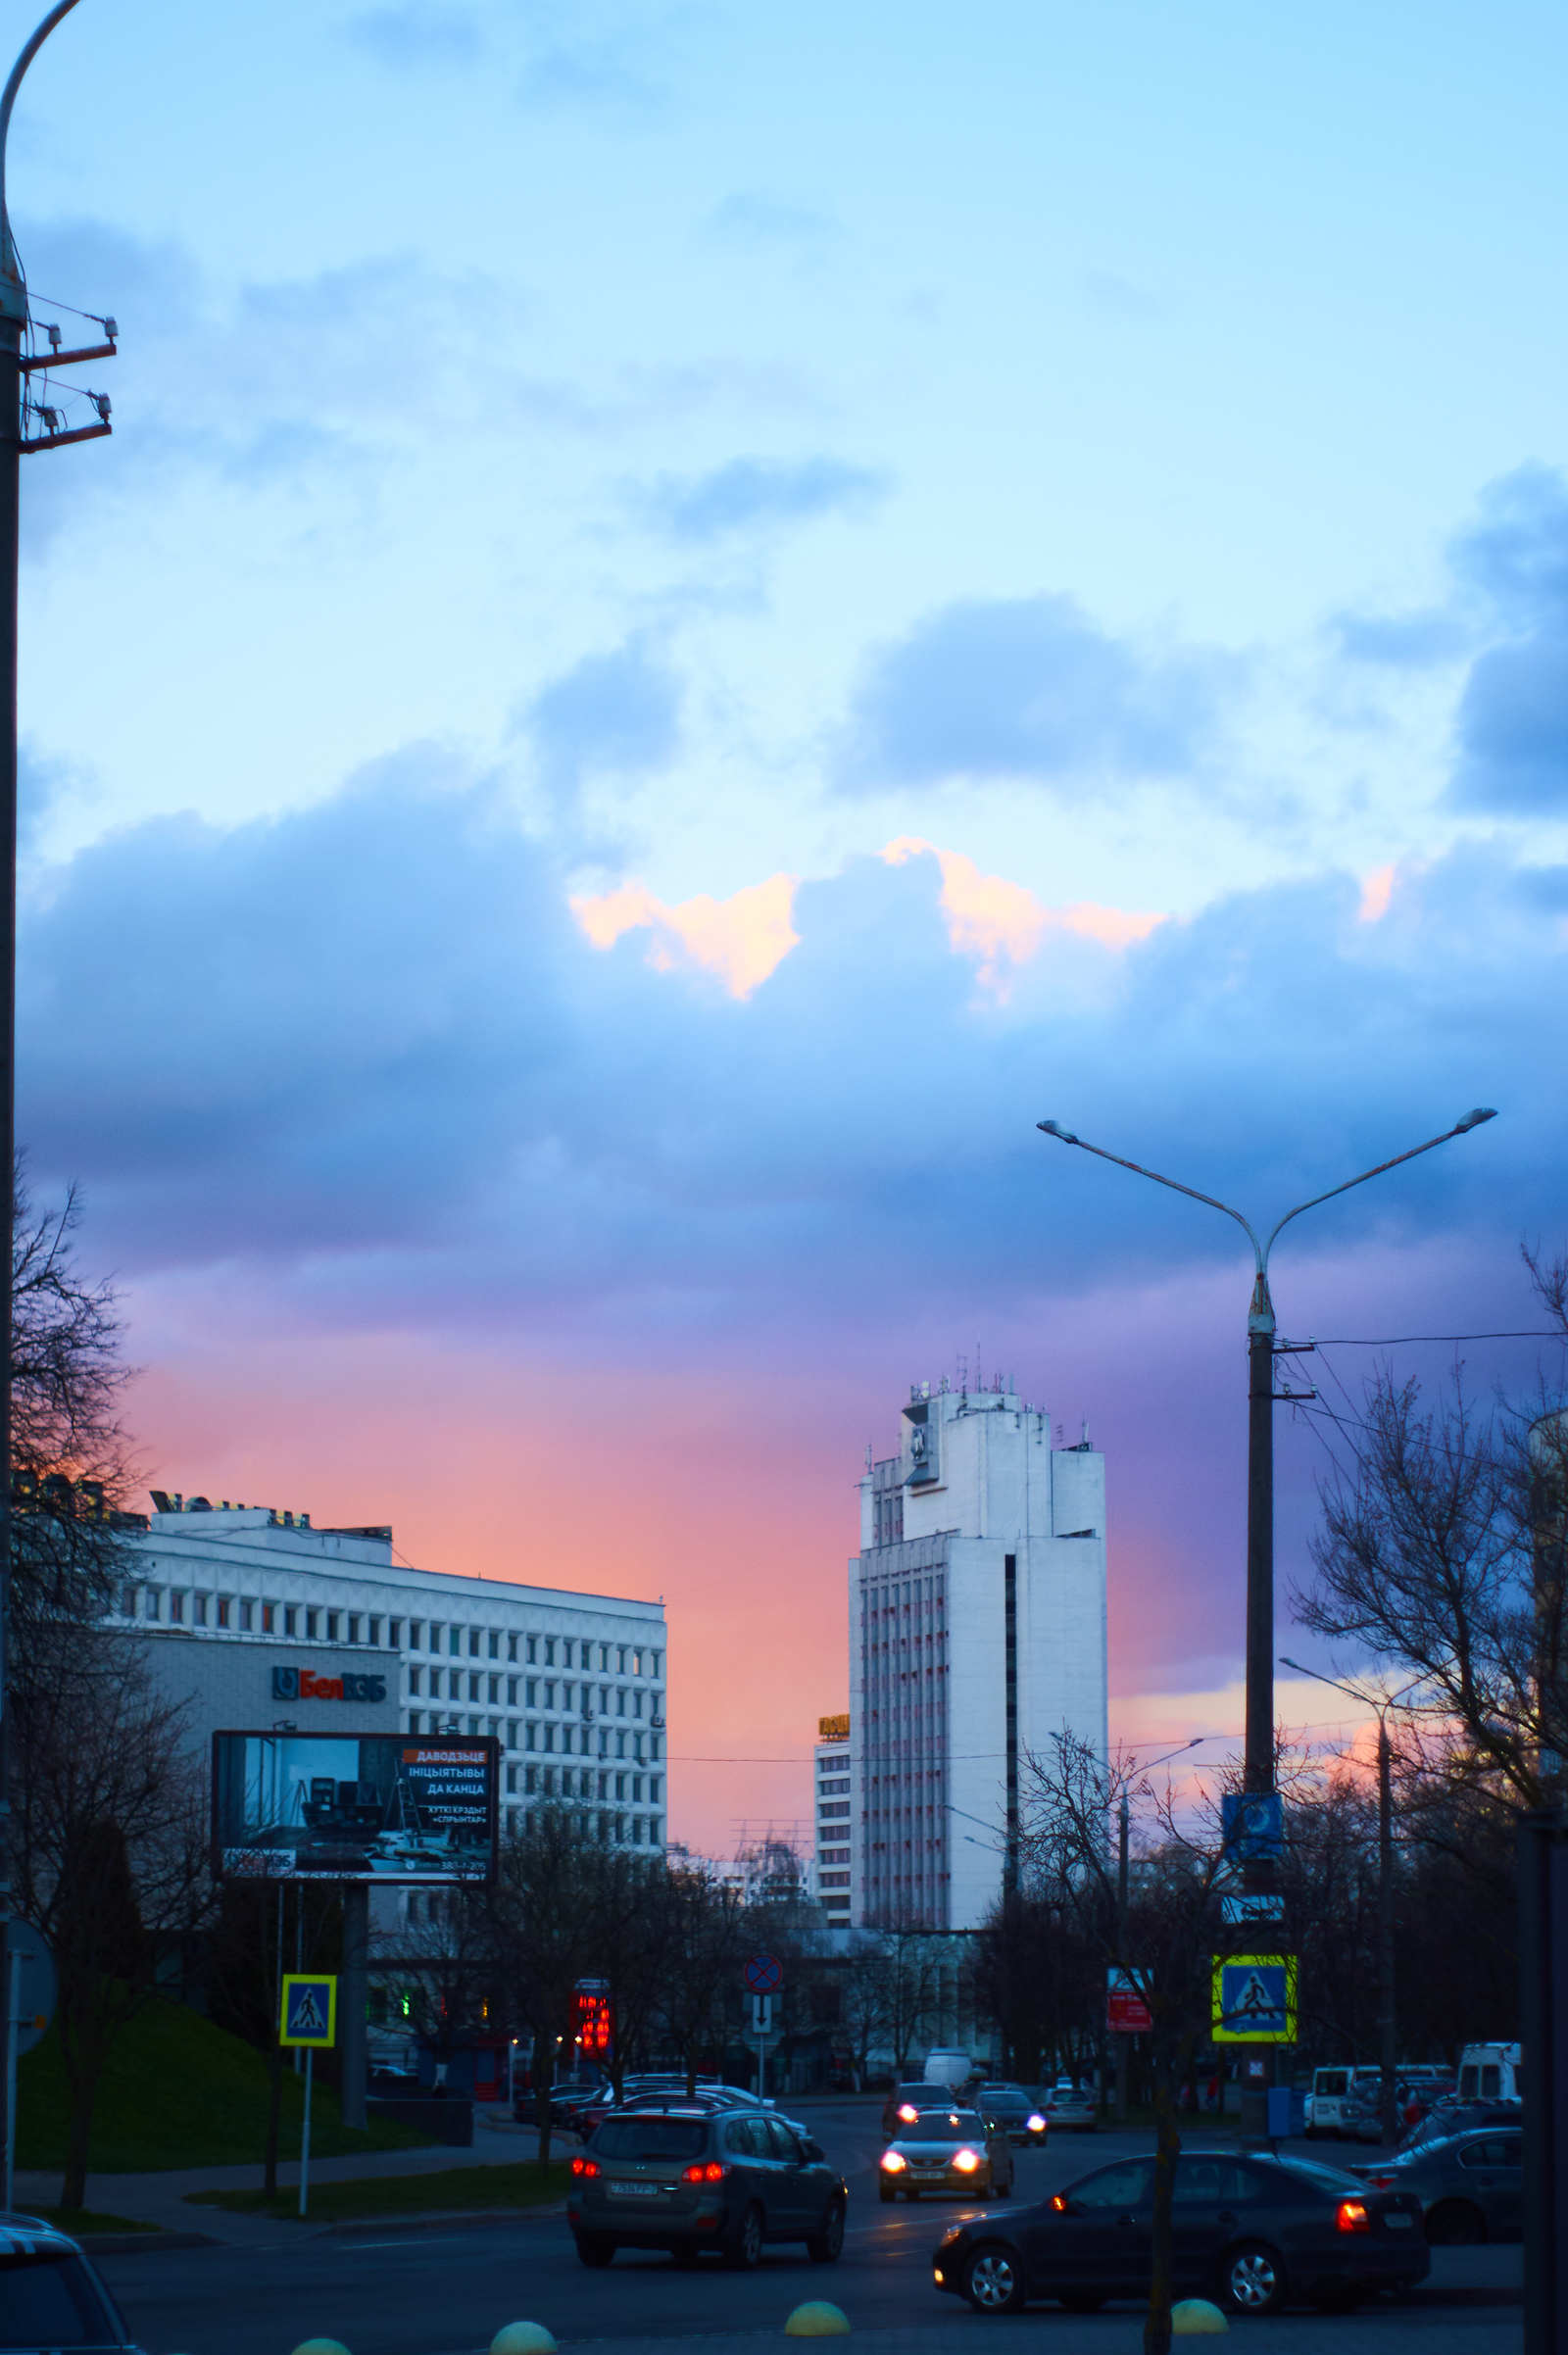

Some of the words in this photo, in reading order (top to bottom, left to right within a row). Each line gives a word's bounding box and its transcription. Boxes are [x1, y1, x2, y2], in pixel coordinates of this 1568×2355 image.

[417, 1752, 485, 1763] ДАВОДЗЬЦЕ
[410, 1767, 484, 1778] ІНІЦЫЯТЫВЫ
[427, 1785, 444, 1794] ДА
[447, 1785, 483, 1795] КАНЦА
